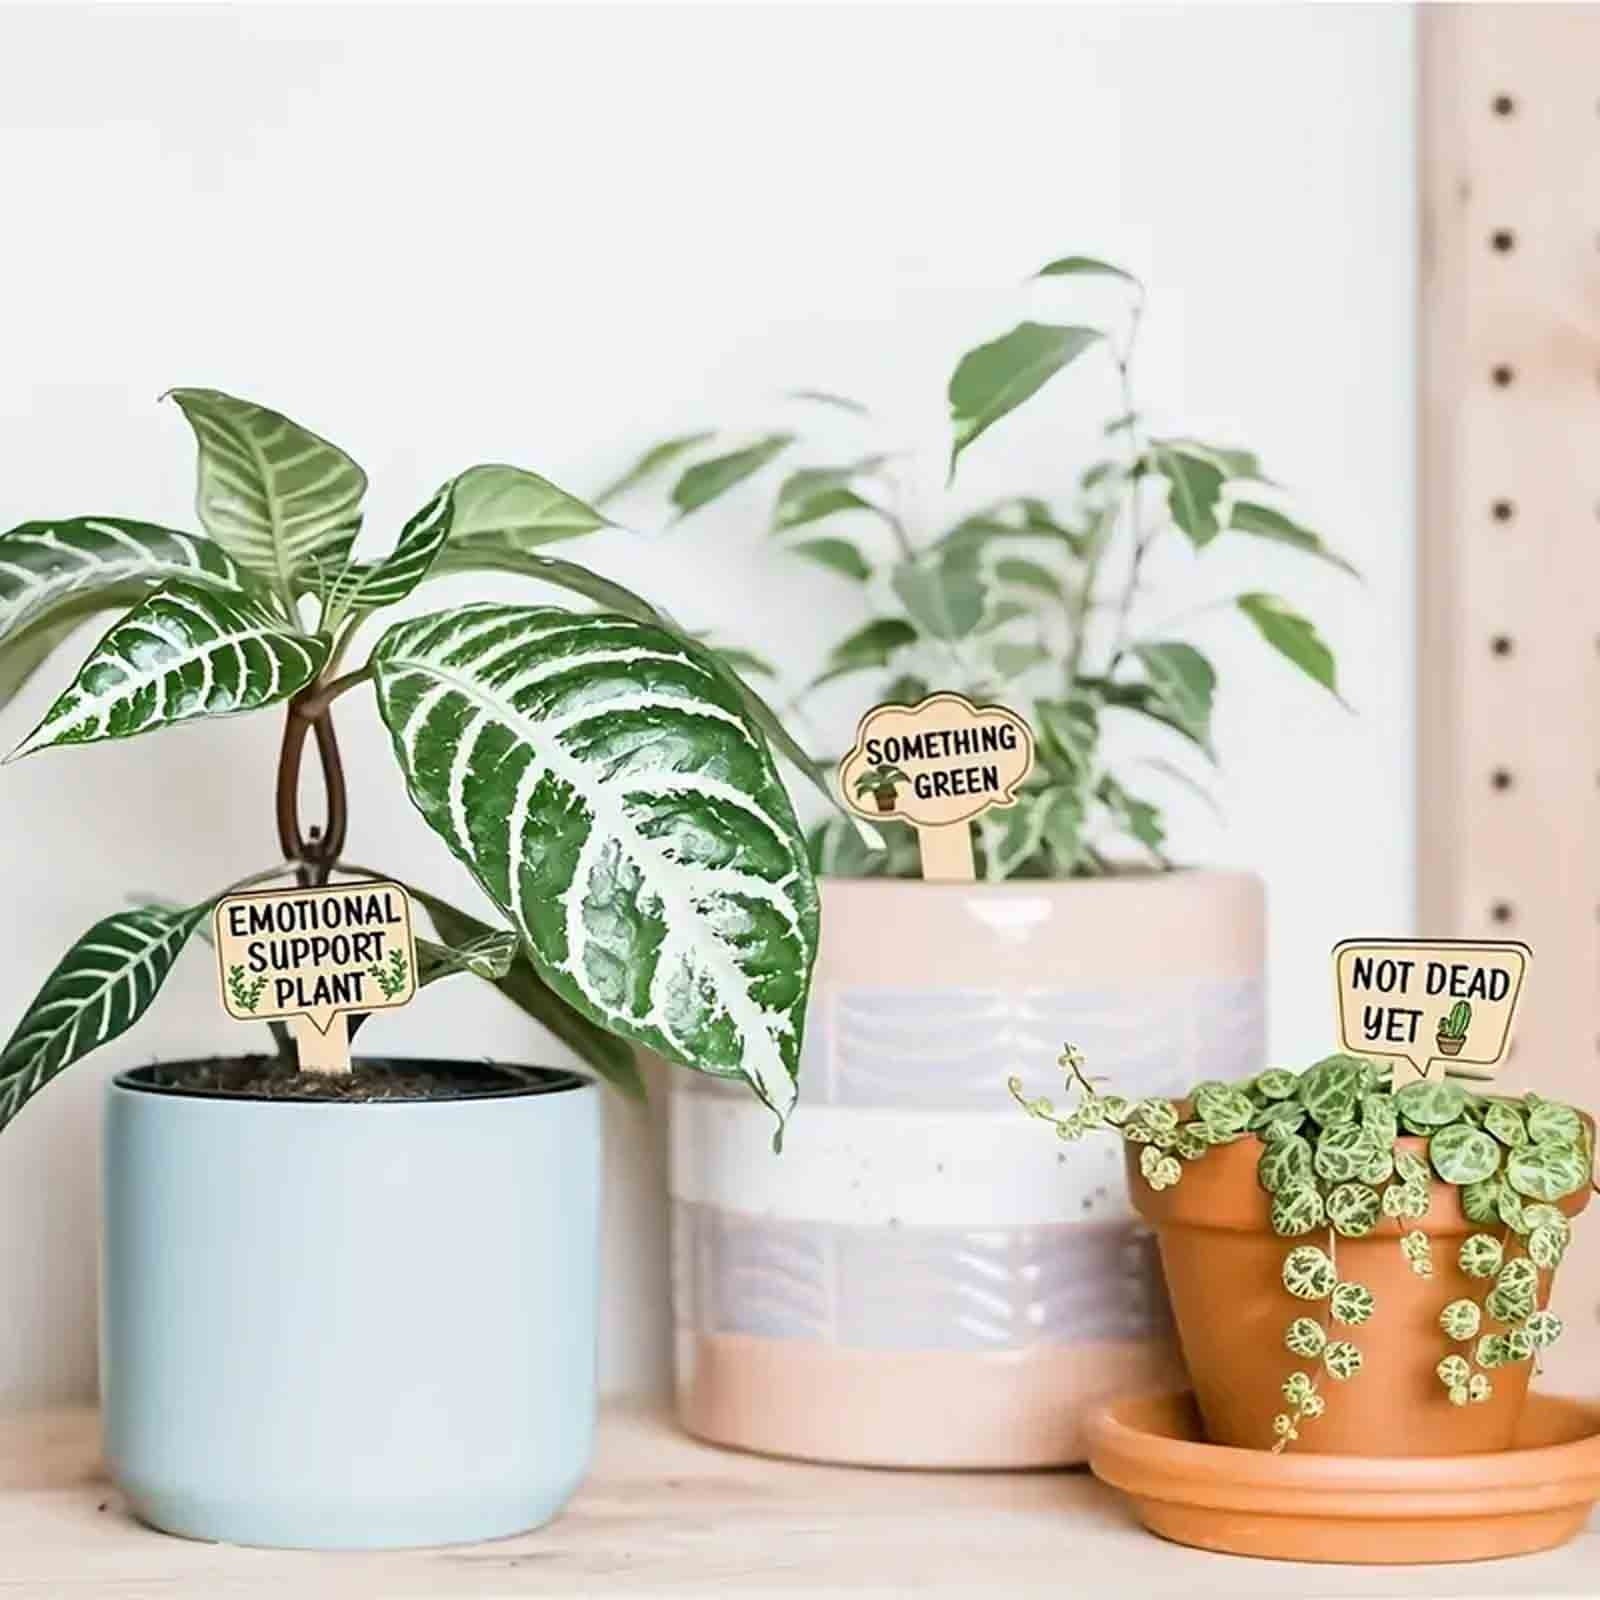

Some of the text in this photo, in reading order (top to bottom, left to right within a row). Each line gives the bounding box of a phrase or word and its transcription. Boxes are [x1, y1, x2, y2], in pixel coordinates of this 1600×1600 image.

[866, 723, 1017, 765] SOMETHING
[914, 765, 999, 799] GREEN
[228, 893, 402, 936] EMOTIONAL
[248, 931, 386, 972] SUPPORT
[275, 972, 365, 1008] PLANT
[1352, 957, 1510, 1002] NOT DEAD
[1363, 1005, 1423, 1043] YET
